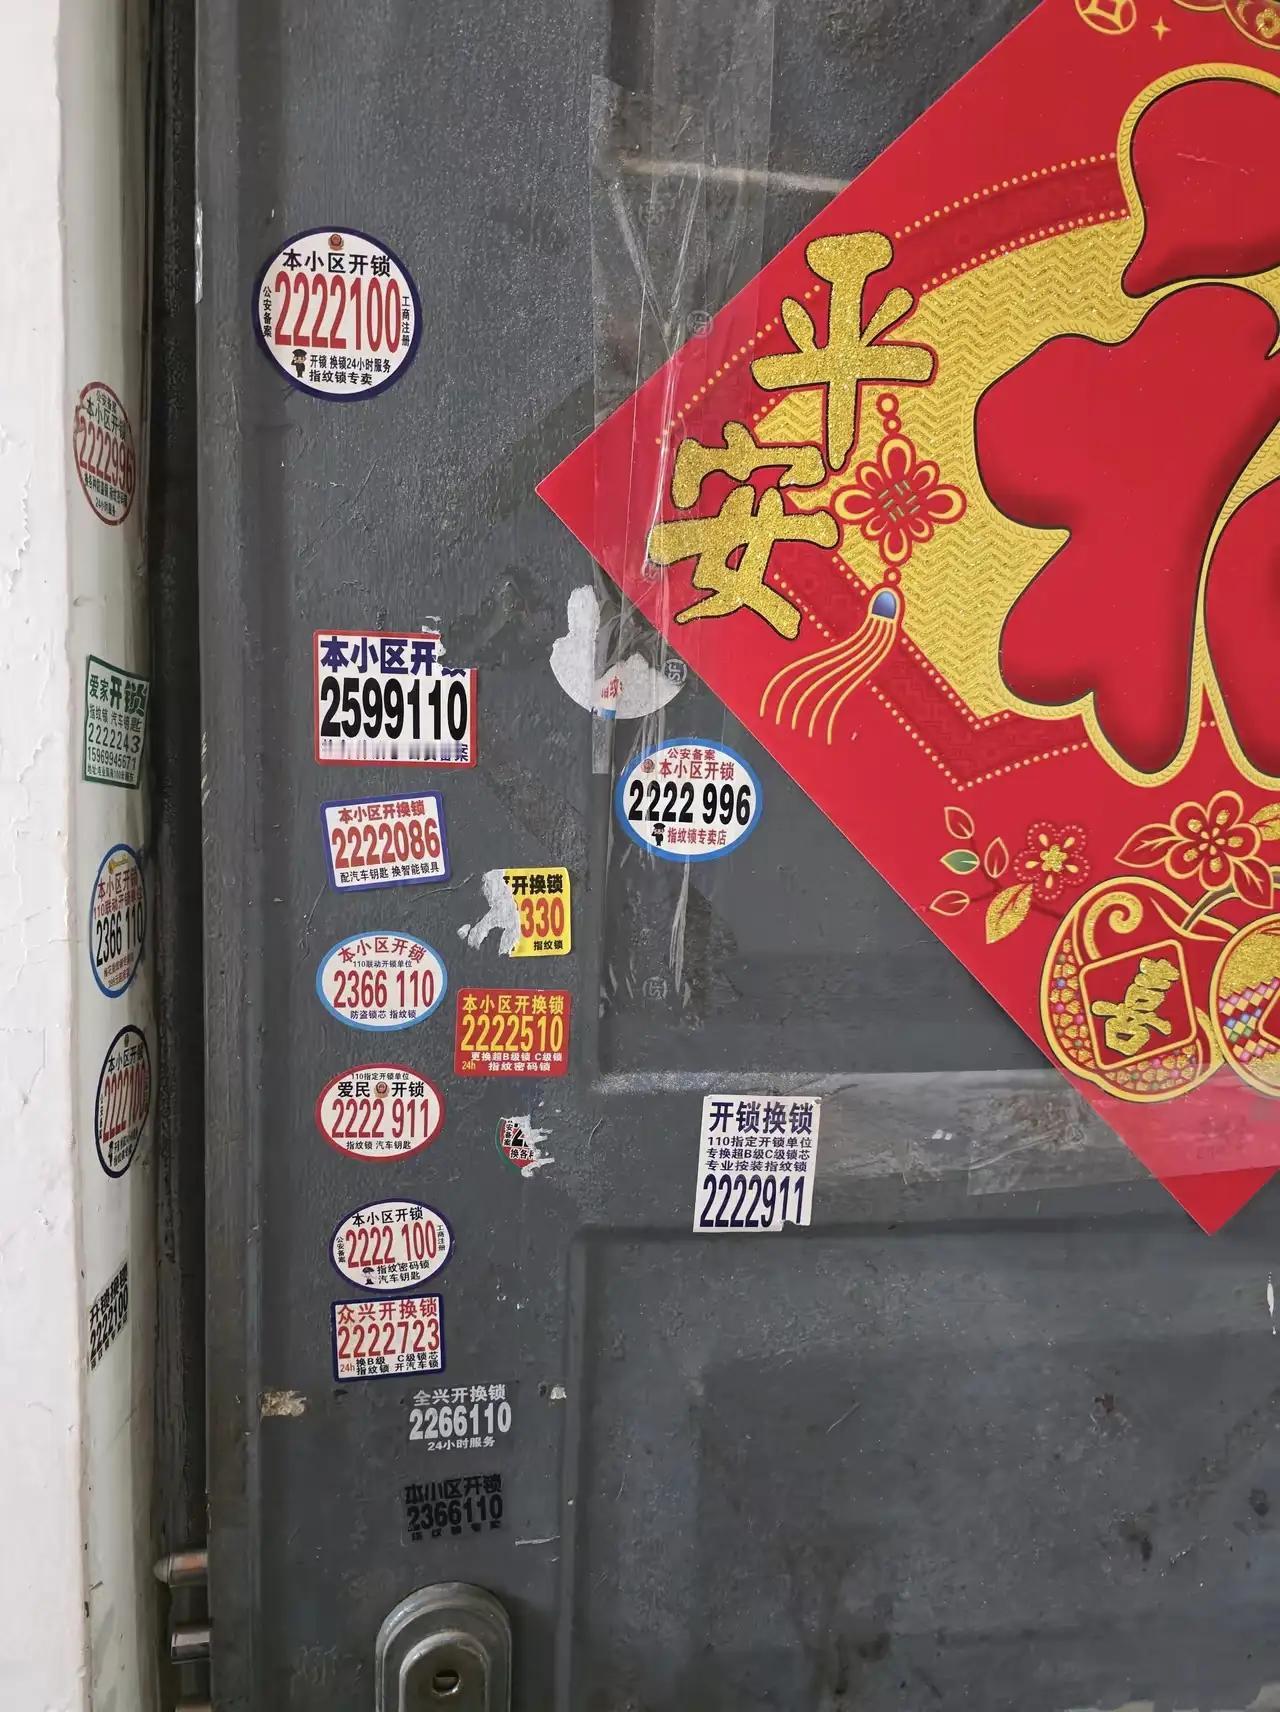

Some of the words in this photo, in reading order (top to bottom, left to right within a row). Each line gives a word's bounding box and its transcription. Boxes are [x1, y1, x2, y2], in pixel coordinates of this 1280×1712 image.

[282, 248, 392, 277] 本小区开锁
[262, 286, 272, 337] 公安备案
[274, 270, 401, 353] 2222100
[401, 296, 411, 347] 工商注册
[309, 371, 373, 385] 指纹锁专卖
[647, 231, 936, 640] 平安
[79, 415, 135, 495] 2222996
[320, 636, 467, 677] 本小区开
[320, 676, 467, 740] 2599110
[87, 722, 140, 754] 2222243
[667, 748, 716, 761] 公安备案
[659, 758, 735, 781] 本小区开锁
[338, 800, 425, 824] 本小区开换锁
[331, 818, 440, 869] 2222086
[667, 827, 727, 845] 指纹锁专卖店
[340, 867, 389, 883] 配汽车钥匙
[392, 862, 440, 877] 换智能锁具
[503, 874, 563, 895] 开换锁
[338, 937, 427, 963] 本小区开锁
[533, 940, 564, 951] 指纹锁
[353, 960, 412, 968] 110联动开锁单位
[350, 1010, 386, 1019] 防盗锁芯
[389, 1010, 417, 1019] 指纹锁
[462, 993, 564, 1015] 本小区开换锁
[460, 1014, 563, 1052] 2222510
[462, 1061, 476, 1070] 24h
[471, 1052, 531, 1061] 更换超B级锁
[534, 1052, 563, 1062] C级锁
[488, 1062, 551, 1072] 指纹密码锁
[352, 1072, 409, 1081] 110指定开锁单位
[338, 1081, 370, 1098] 爱民
[391, 1081, 425, 1098] 开锁
[709, 1101, 813, 1135] 开锁换锁
[346, 1141, 372, 1150] 指纹锁
[375, 1141, 411, 1150] 汽车钥匙
[707, 1136, 812, 1149] 110指定开锁单位
[706, 1148, 811, 1161] 专换超B级C级锁芯
[705, 1160, 807, 1173] 专业按装指纹锁
[700, 1174, 805, 1228] 2222911
[352, 1206, 424, 1227] 本小区开锁
[377, 1260, 430, 1275] 指纹密码锁
[378, 1271, 420, 1284] 汽车钥匙
[338, 1299, 437, 1324] 众兴开换锁
[338, 1318, 440, 1359] 2222723
[340, 1364, 355, 1373] 24h
[356, 1356, 385, 1366] 换B级
[397, 1351, 438, 1363] C级锁芯
[356, 1365, 389, 1376] 指纹锁
[395, 1360, 439, 1371] 开汽车锁
[413, 1384, 506, 1407] 全兴开换锁
[409, 1402, 512, 1441] 2266110
[427, 1436, 496, 1451] 24小时服务
[405, 1473, 502, 1505] 本小区开锁
[407, 1494, 503, 1532] 2366110
